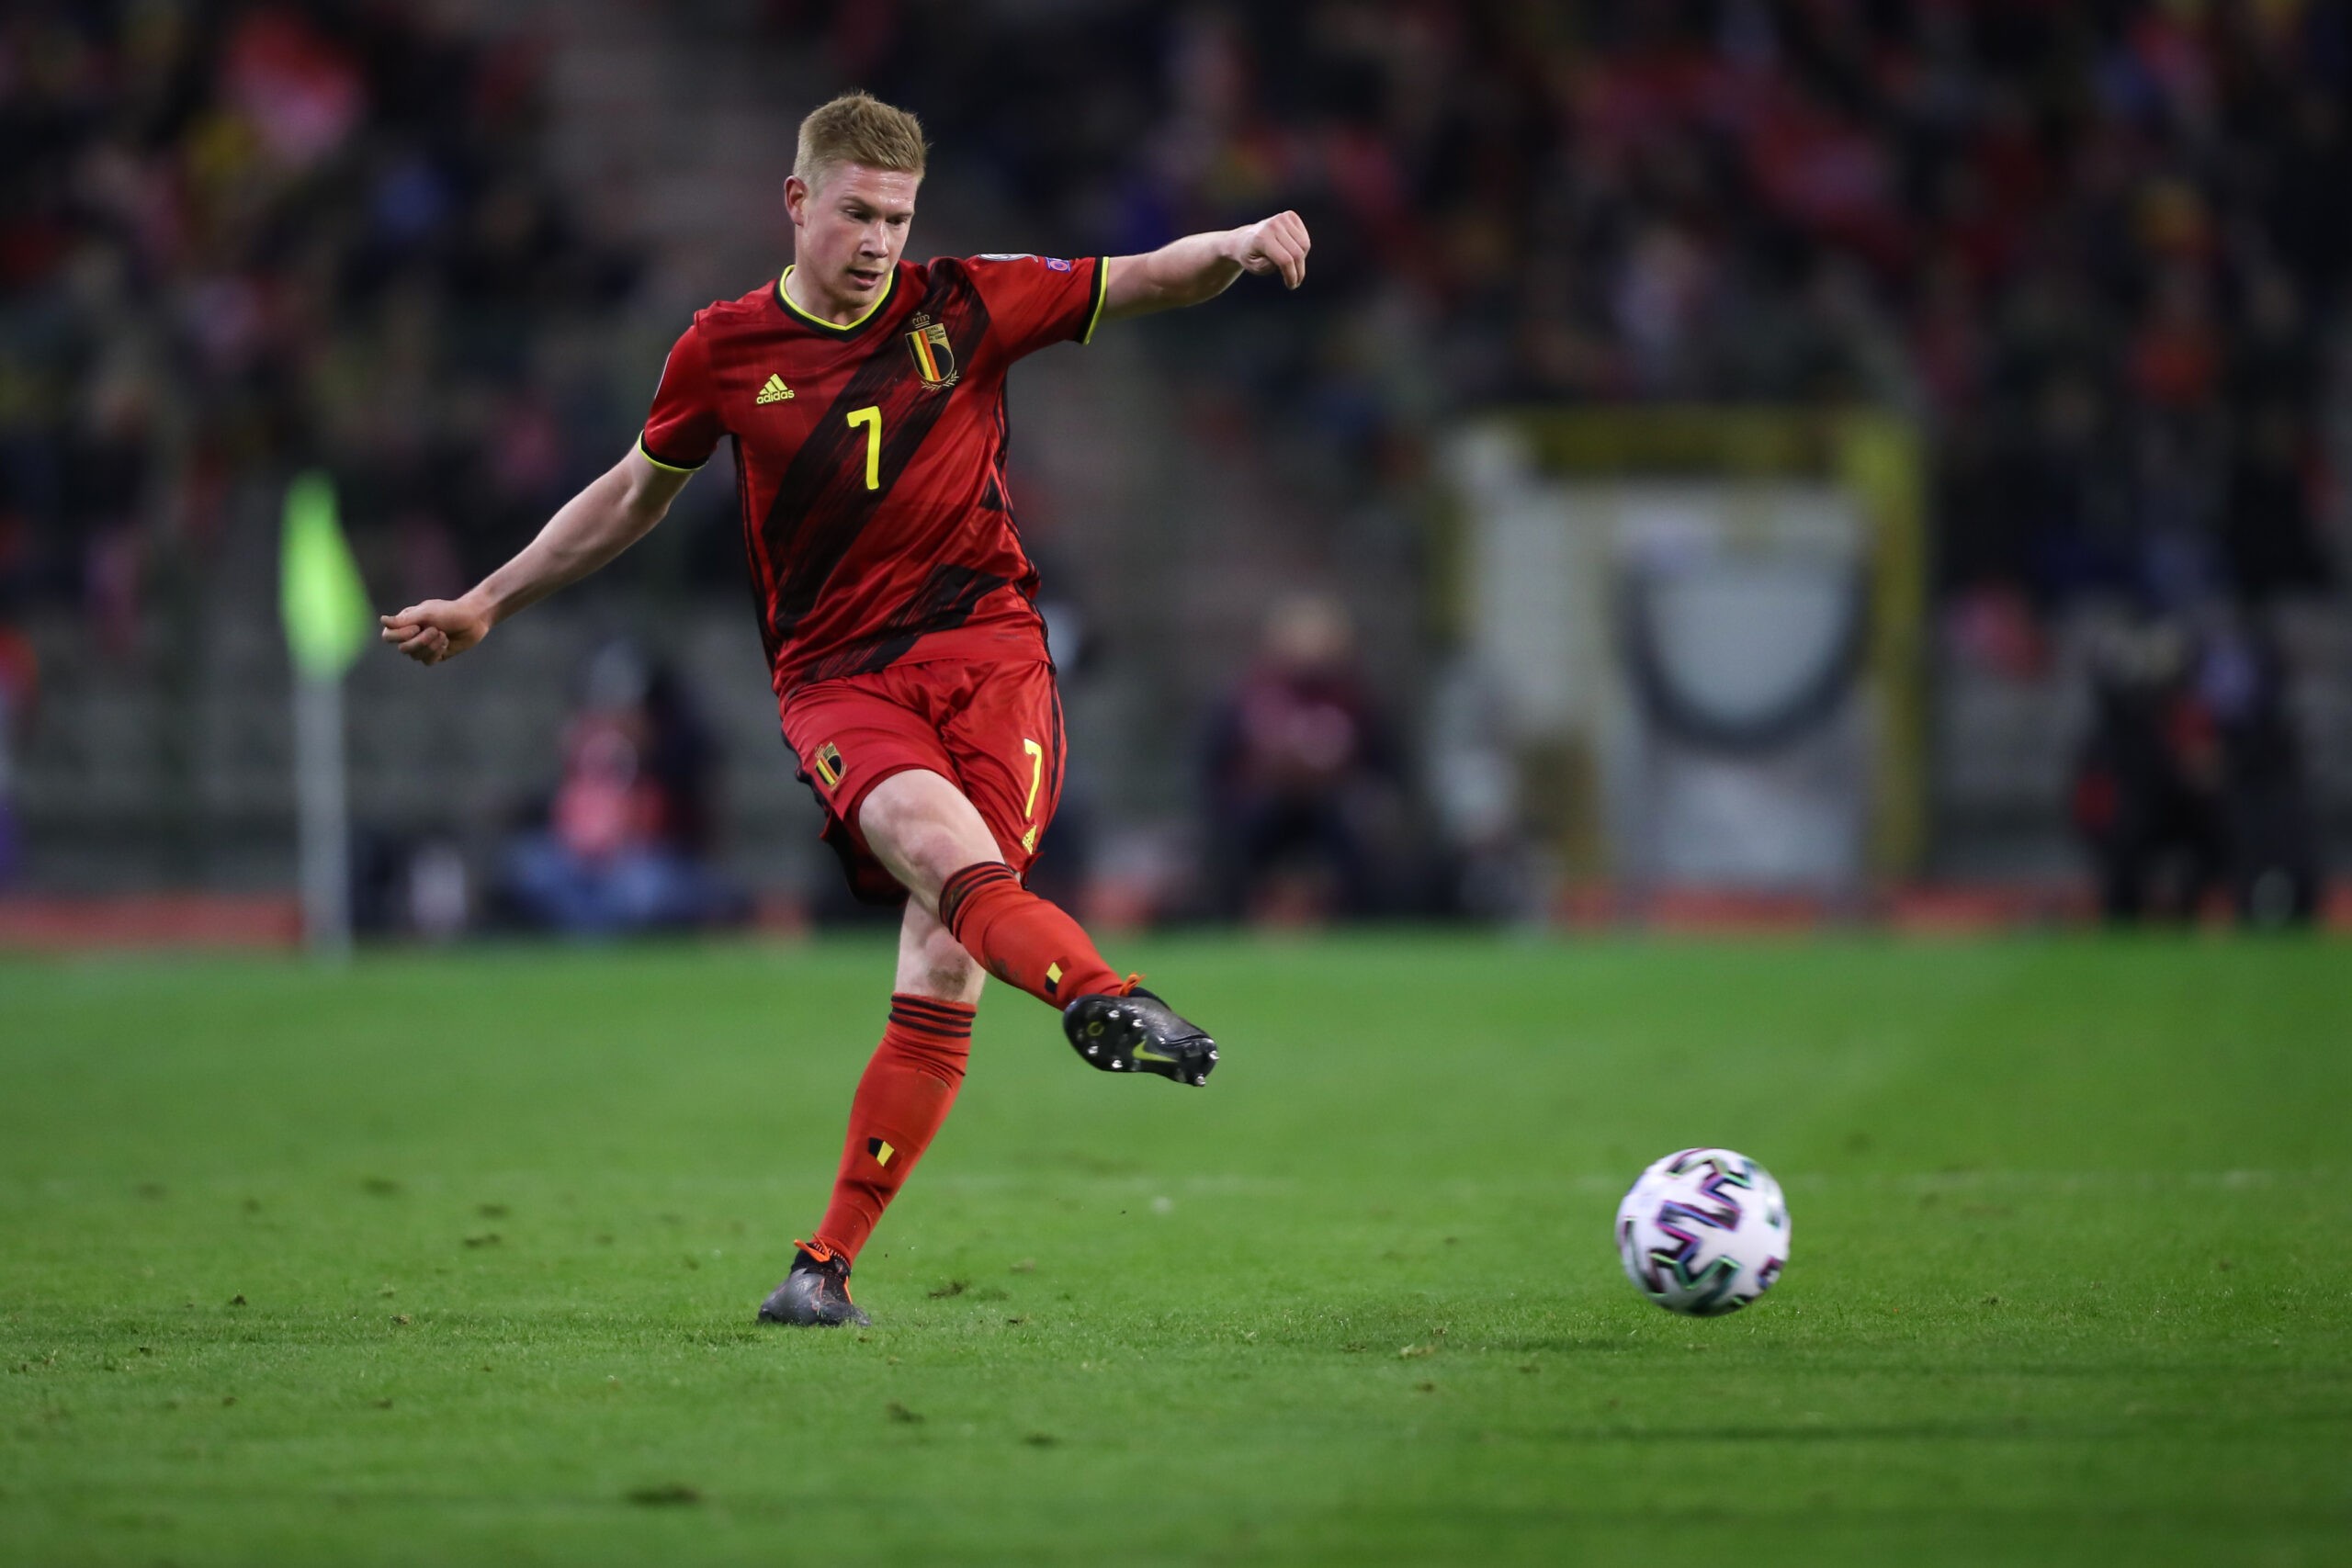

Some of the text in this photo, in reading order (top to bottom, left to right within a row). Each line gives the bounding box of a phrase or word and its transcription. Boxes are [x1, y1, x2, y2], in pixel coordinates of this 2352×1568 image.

[756, 389, 795, 404] adidas
[847, 405, 881, 490] 7
[1023, 738, 1042, 818] 7
